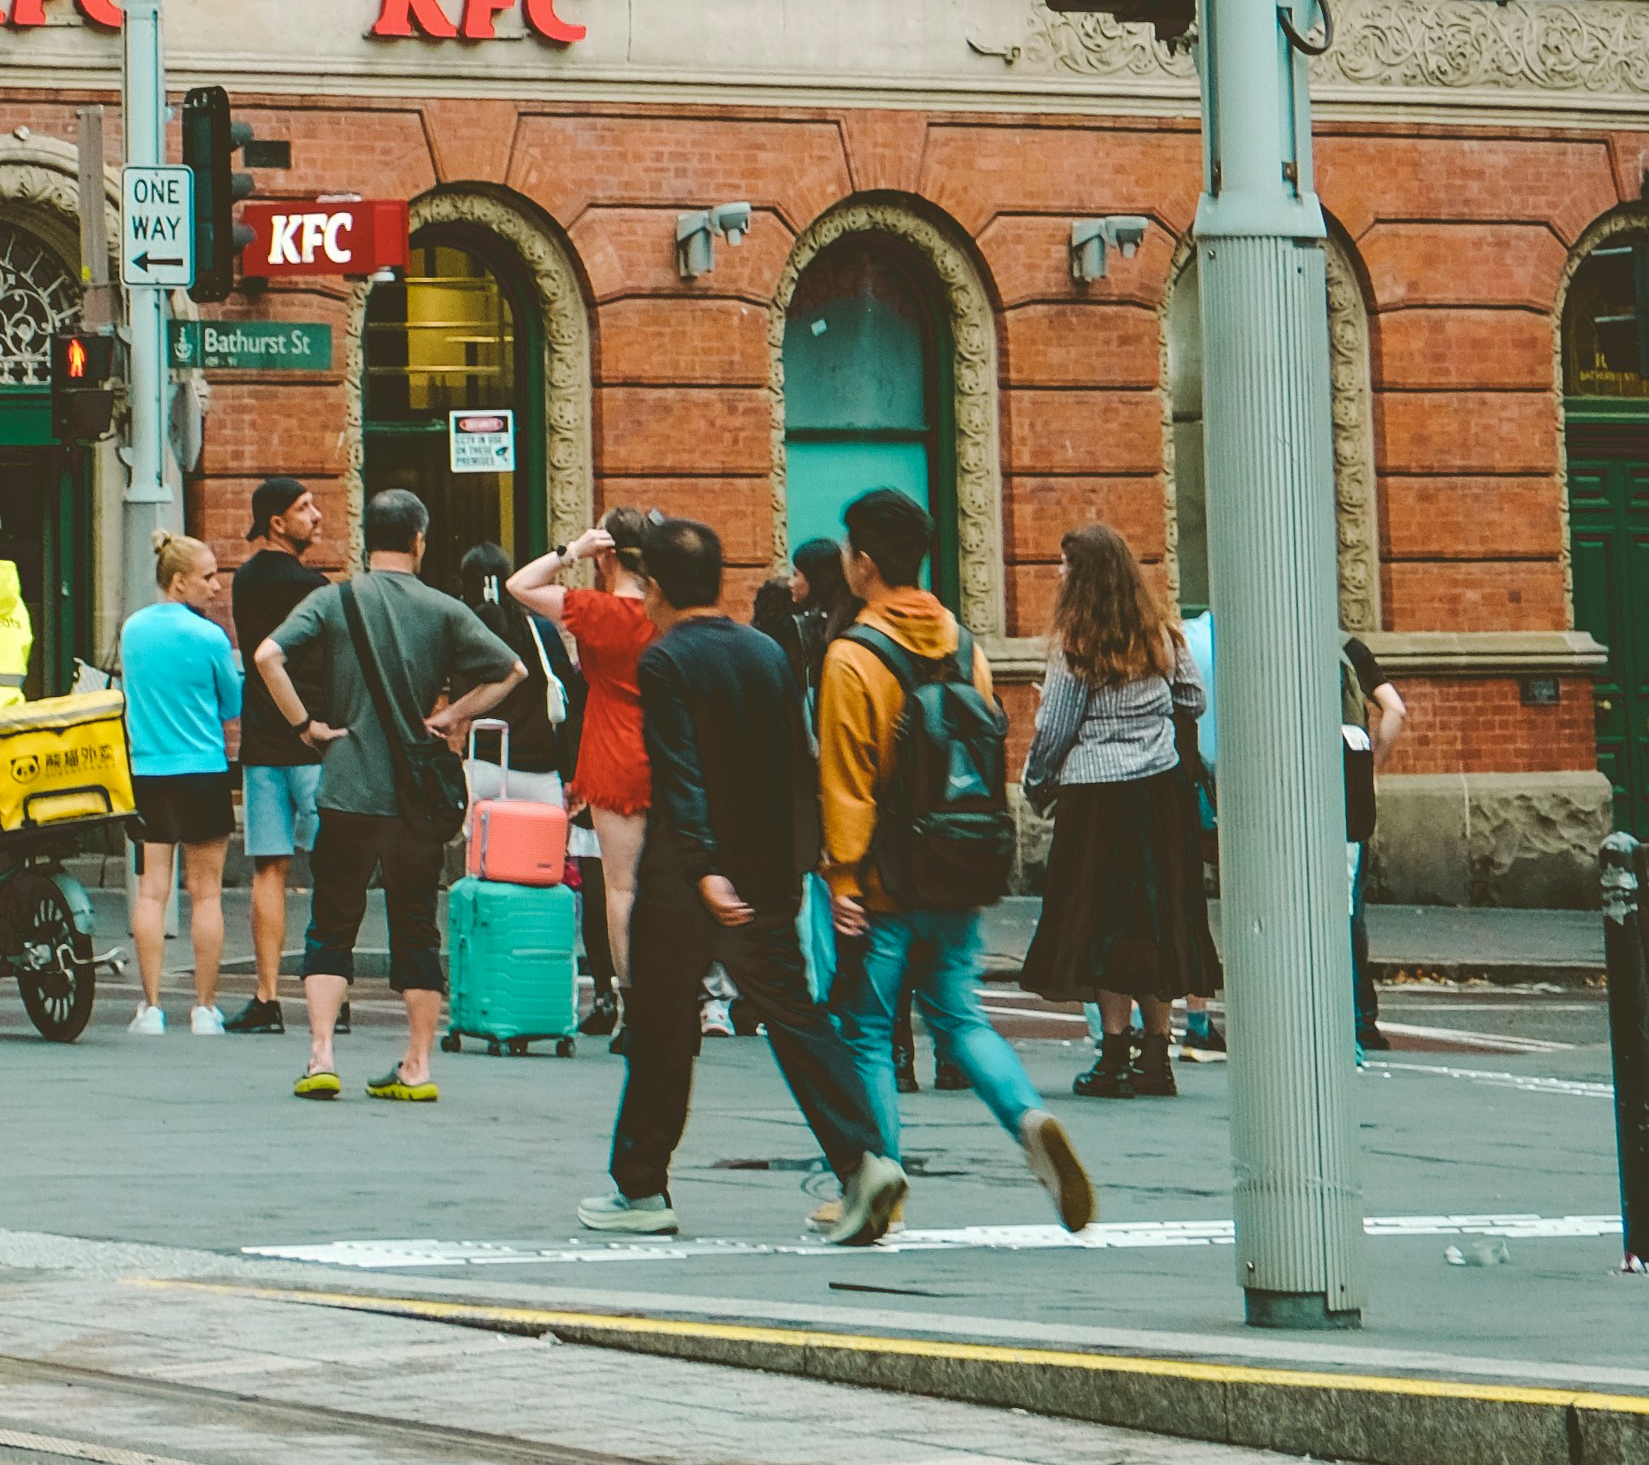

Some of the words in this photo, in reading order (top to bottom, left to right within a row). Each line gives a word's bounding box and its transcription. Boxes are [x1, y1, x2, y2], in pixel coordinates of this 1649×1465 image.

[134, 179, 180, 204] ONE
[132, 215, 181, 241] WAY
[267, 212, 353, 264] KFC
[204, 327, 287, 355] Bathurst
[290, 329, 311, 355] St
